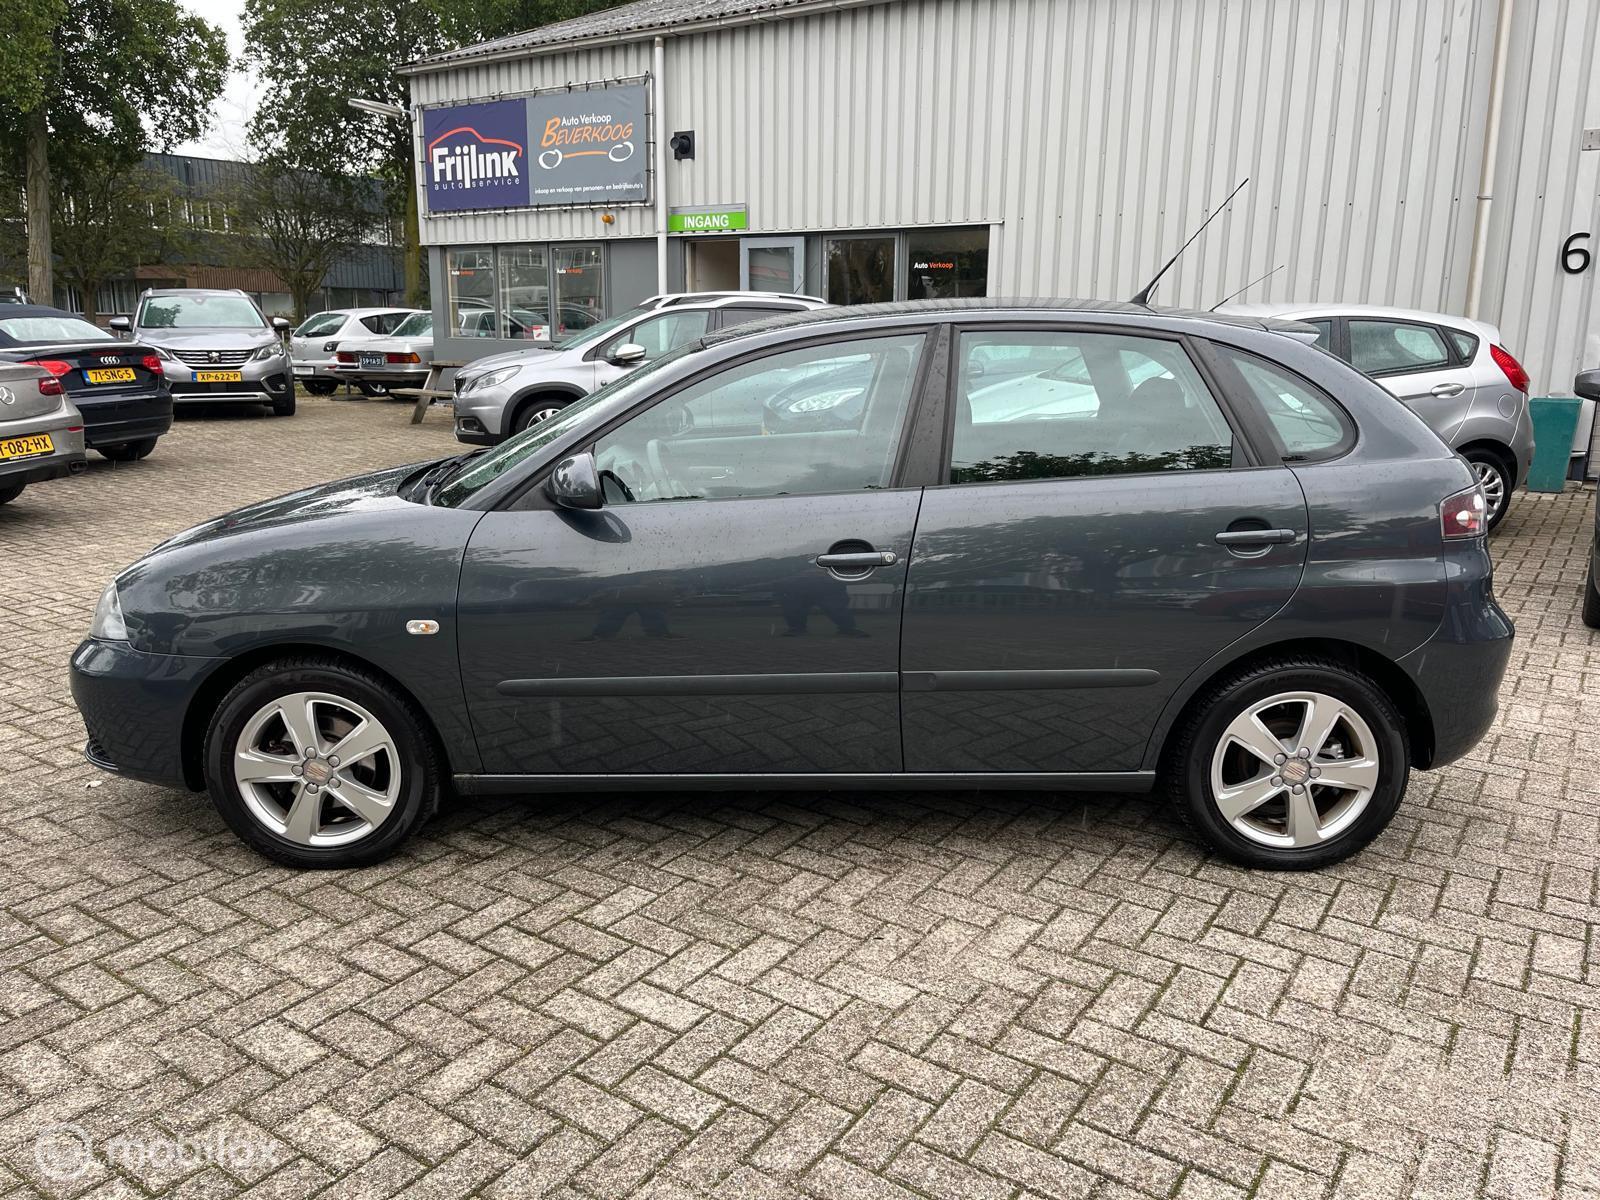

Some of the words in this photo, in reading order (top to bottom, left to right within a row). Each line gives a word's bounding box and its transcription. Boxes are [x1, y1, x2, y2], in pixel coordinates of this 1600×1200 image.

[561, 116, 579, 126] Auto
[580, 113, 612, 124] Verkoop
[432, 144, 519, 189] Frijlink
[684, 215, 729, 228] INGANG
[1561, 232, 1591, 274] 6
[200, 373, 239, 381] XP-622-P
